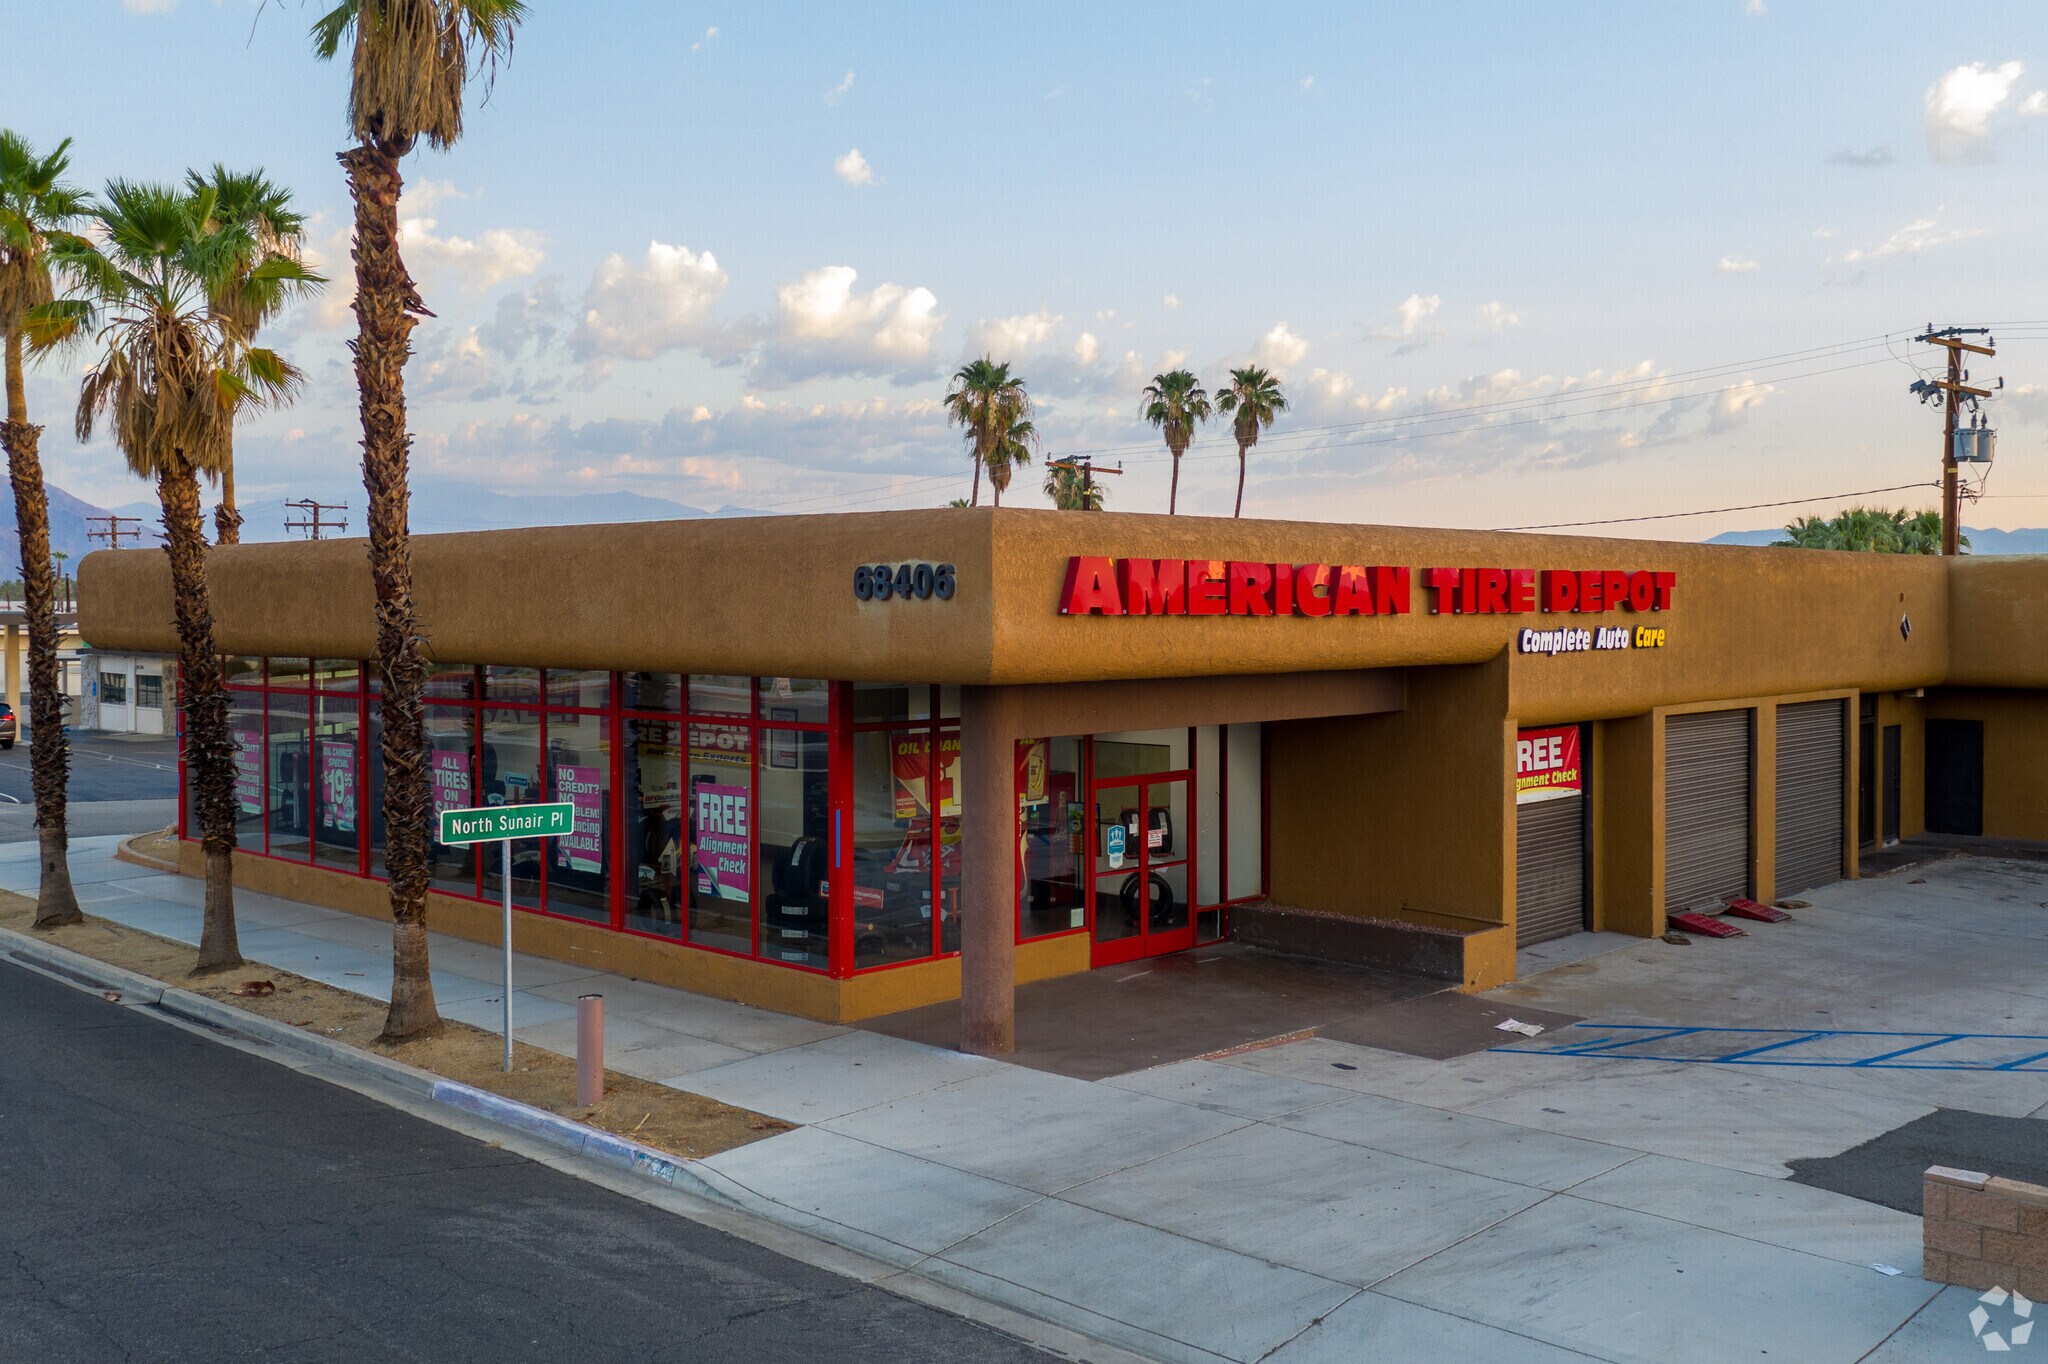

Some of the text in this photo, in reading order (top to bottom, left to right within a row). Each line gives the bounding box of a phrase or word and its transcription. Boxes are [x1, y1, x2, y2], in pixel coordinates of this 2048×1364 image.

[854, 563, 956, 601] 68406
[1058, 555, 1676, 617] AMERICAN TIRE DEPOT
[1518, 625, 1666, 656] Complete Auto Care
[898, 742, 920, 755] OIL
[1517, 736, 1563, 773] REE
[441, 757, 459, 770] ALL
[434, 769, 468, 791] TIRES
[558, 768, 575, 782] NO
[1516, 768, 1577, 791] gnment Check
[444, 789, 458, 802] ON
[558, 782, 599, 795] CREDIT?
[558, 792, 575, 803] NO
[574, 806, 600, 819] BLEM!
[698, 792, 747, 836] FREE
[452, 812, 563, 835] North Sunair Pl
[573, 818, 600, 838] ancing
[558, 835, 600, 852] AVAILABLE
[699, 836, 747, 856] Alignment
[718, 856, 746, 875] Check
